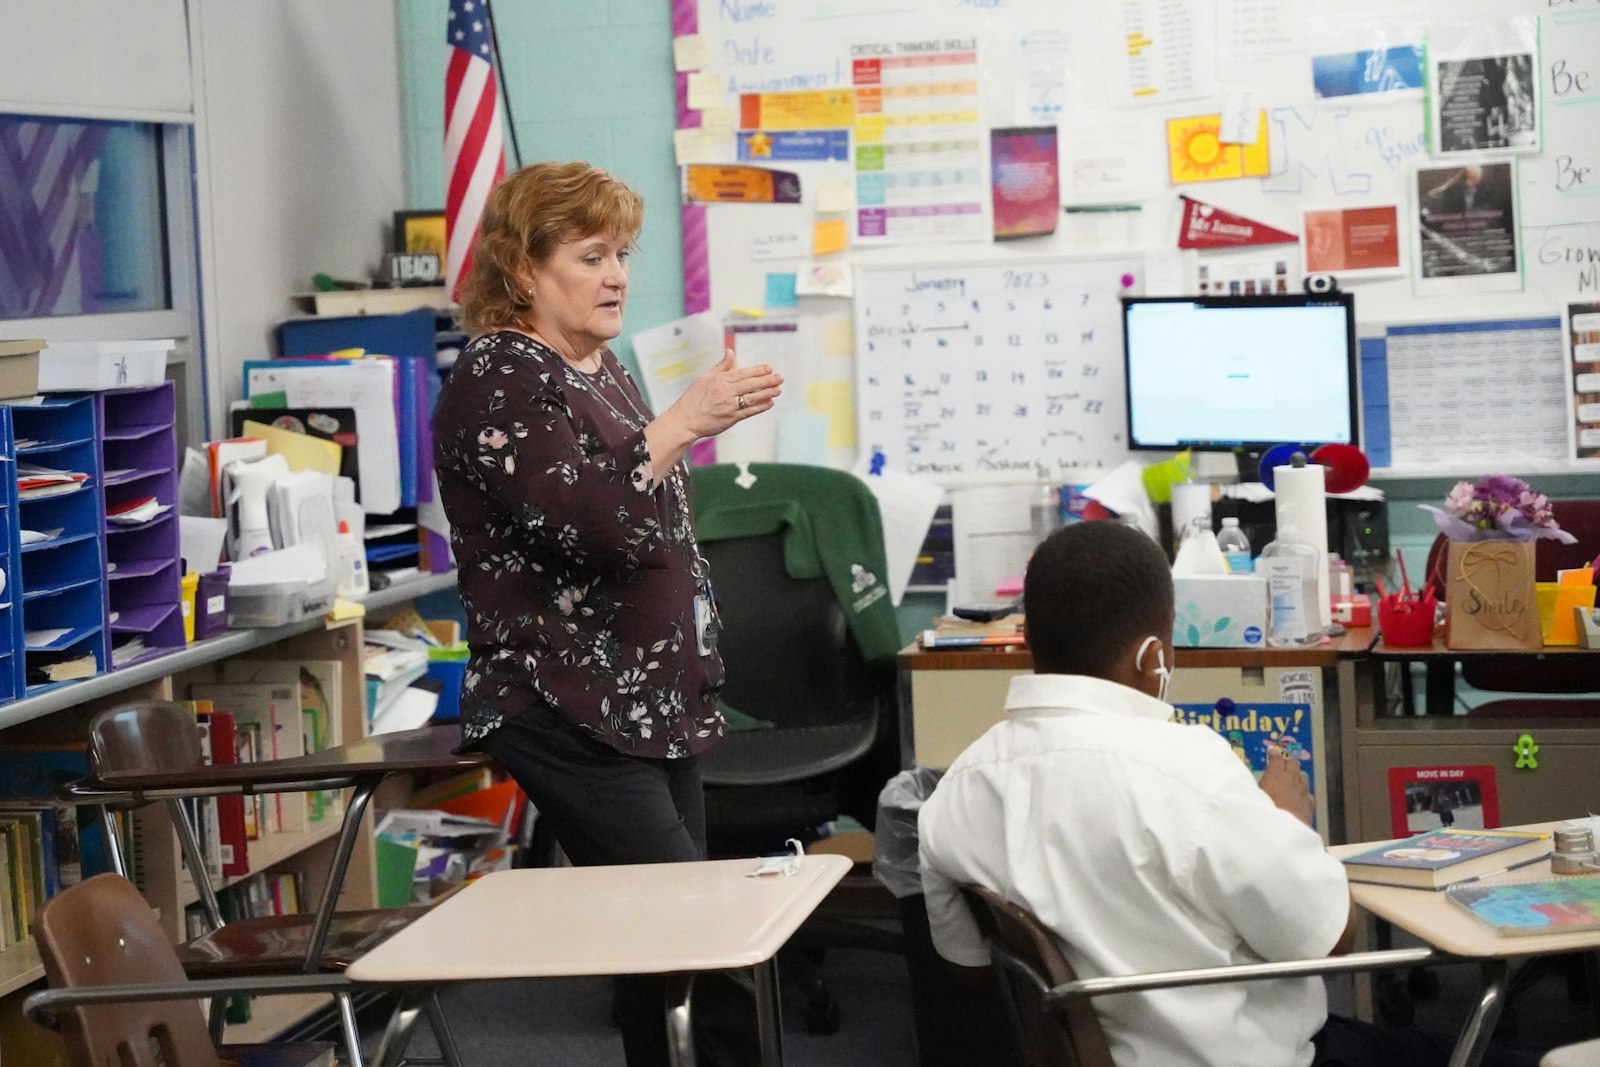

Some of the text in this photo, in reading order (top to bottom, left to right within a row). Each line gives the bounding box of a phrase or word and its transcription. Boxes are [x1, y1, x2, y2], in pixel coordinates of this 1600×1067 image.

[724, 37, 775, 65] Date
[849, 37, 977, 56] CRITICAL THINKING SKILLS
[1551, 59, 1591, 94] Be
[1555, 155, 1591, 192] Be
[1002, 270, 1050, 288] 2023
[1416, 769, 1465, 779] MOVE IN DAY
